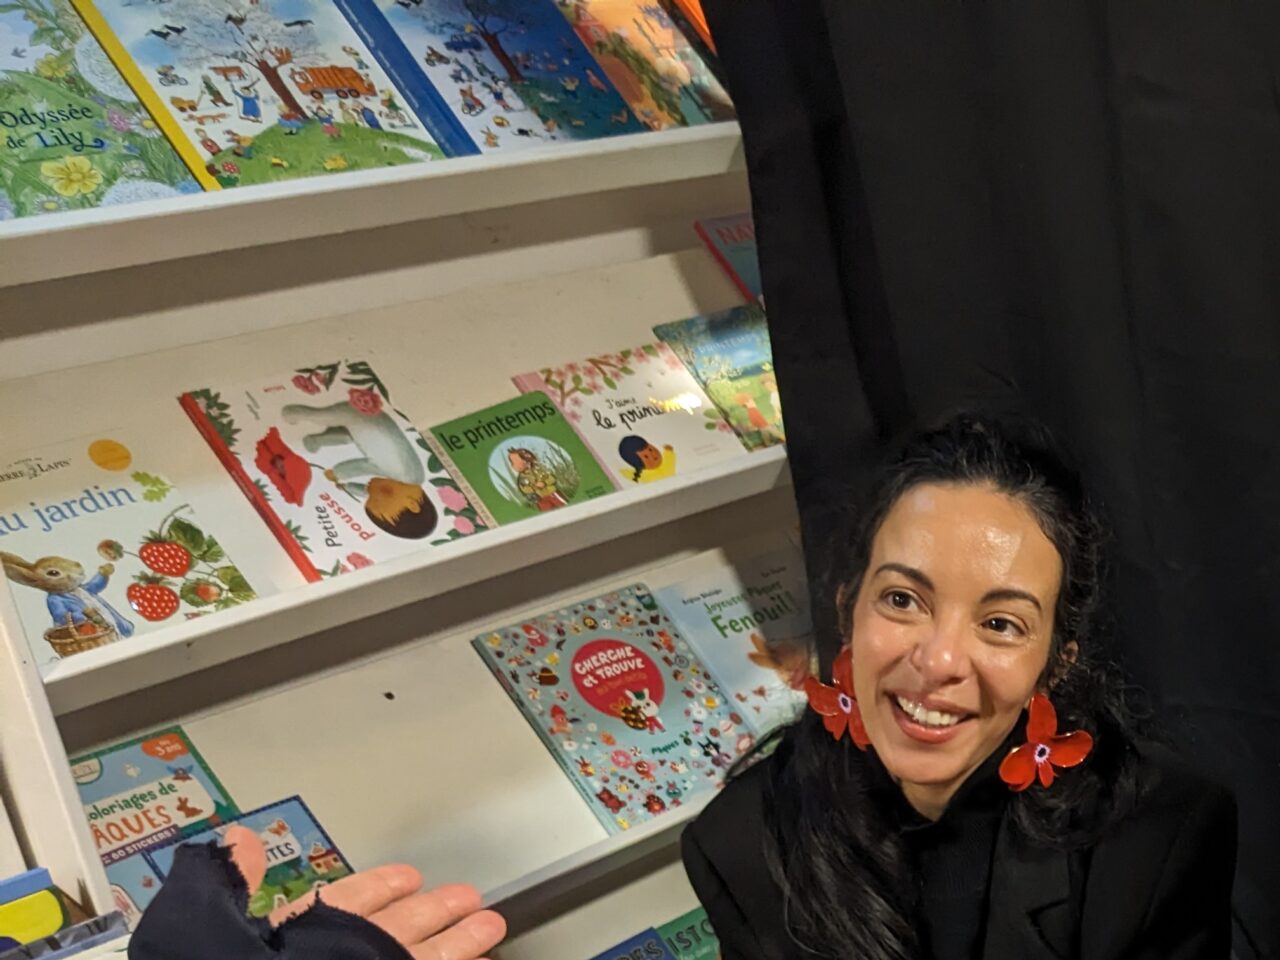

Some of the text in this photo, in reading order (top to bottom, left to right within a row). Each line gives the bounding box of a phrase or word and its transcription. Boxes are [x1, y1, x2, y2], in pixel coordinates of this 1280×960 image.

[0, 104, 94, 129] Odyssée
[6, 127, 105, 152] de Lily
[440, 400, 556, 451] le printemps
[592, 409, 616, 430] le
[0, 485, 137, 536] u jardin
[315, 505, 342, 548] Petite
[319, 492, 376, 541] pousse
[574, 646, 635, 675] CHERCHE
[583, 675, 599, 687] et
[596, 658, 645, 679] TROUVE
[88, 782, 179, 821] oloriages de
[90, 805, 172, 848] ÂQUES
[112, 849, 127, 859] 60
